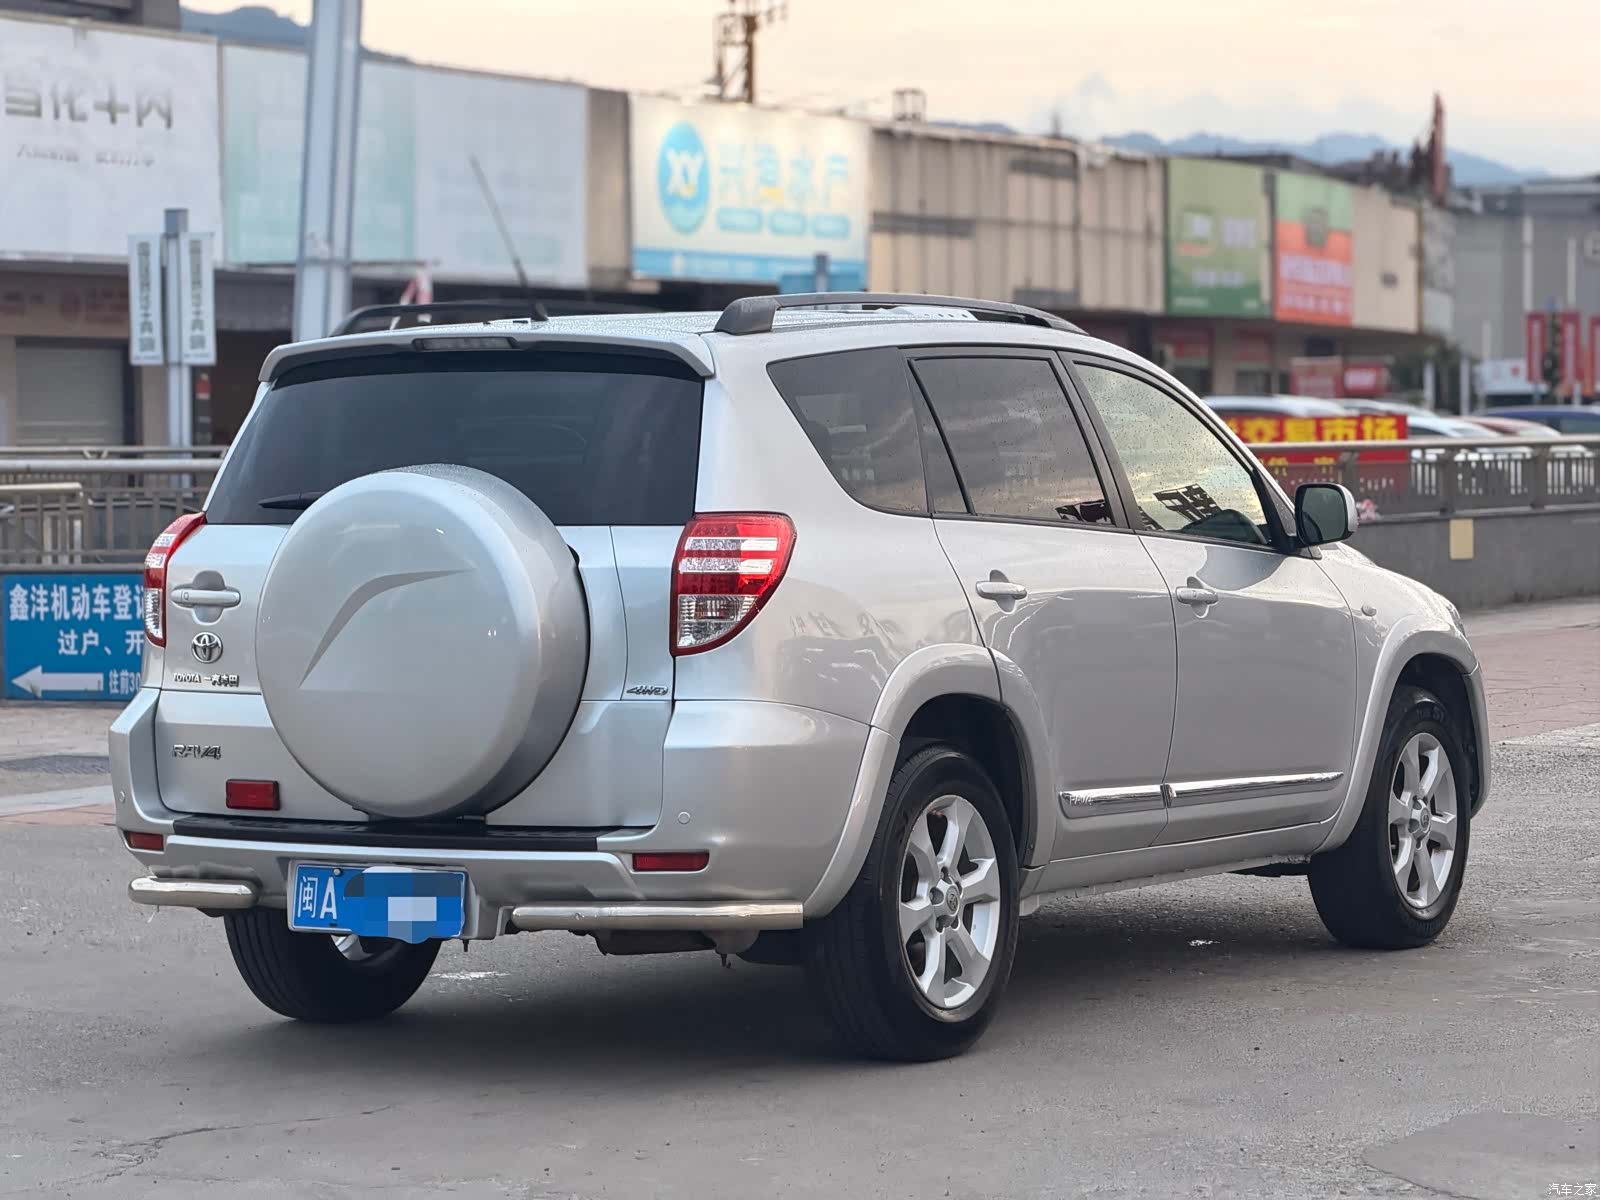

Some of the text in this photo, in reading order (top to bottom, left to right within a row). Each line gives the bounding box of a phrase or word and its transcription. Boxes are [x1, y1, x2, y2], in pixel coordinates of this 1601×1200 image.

[174, 672, 202, 683] TOYOTA
[626, 685, 669, 696] 4WD
[173, 744, 222, 760] RAV4
